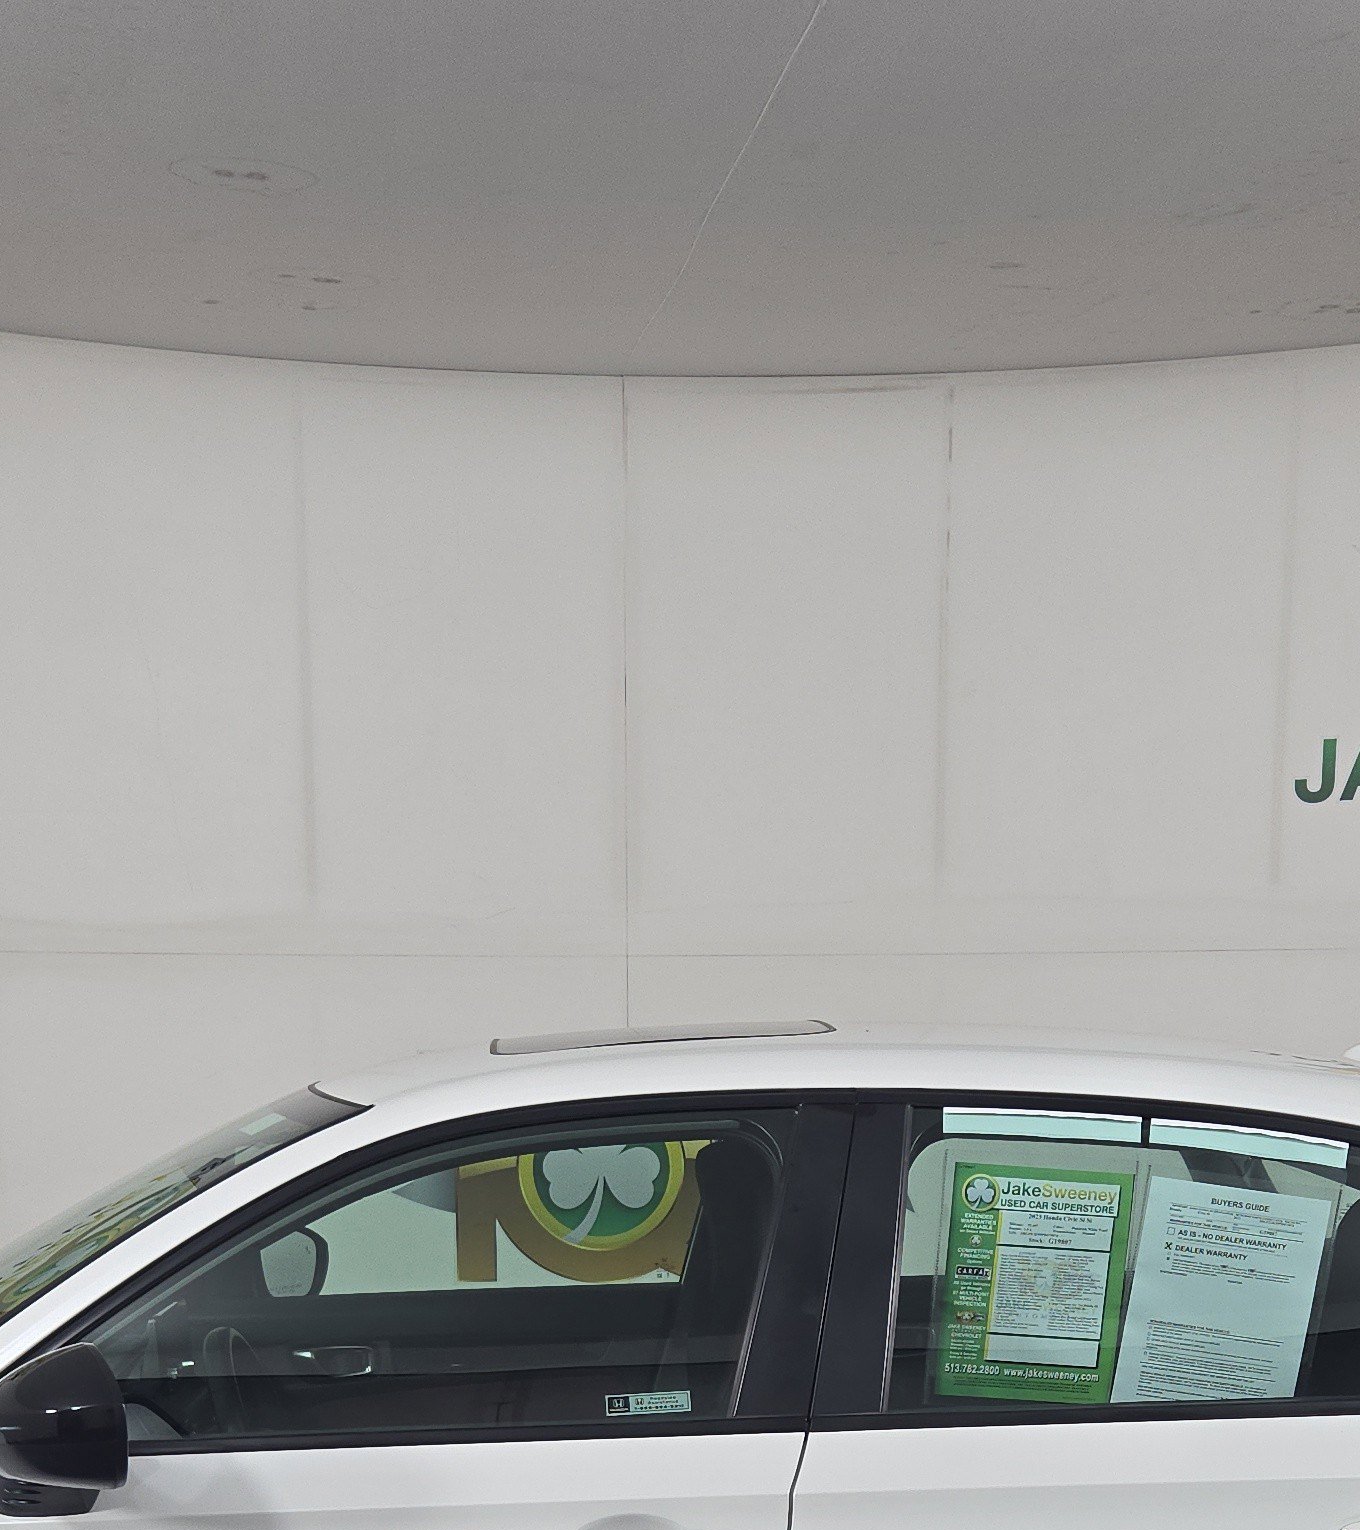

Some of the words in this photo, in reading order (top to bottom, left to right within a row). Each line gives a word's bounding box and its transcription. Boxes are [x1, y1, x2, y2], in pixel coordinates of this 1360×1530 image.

[1000, 1198, 1026, 1208] USED
[1029, 1201, 1048, 1210] CAR
[1051, 1202, 1114, 1214] SUPERSTORE
[1211, 1198, 1244, 1209] BUYERS
[1245, 1202, 1270, 1213] GUIDE
[1178, 1229, 1188, 1237] AS
[1190, 1230, 1197, 1238] IS
[1202, 1232, 1213, 1240] NO
[1215, 1234, 1245, 1245] DEALER
[1245, 1238, 1287, 1250] WARRANTY
[1175, 1244, 1205, 1255] DEALER
[1206, 1249, 1248, 1261] WARRANTY
[1003, 1367, 1099, 1382] www.jakesweeney.com
